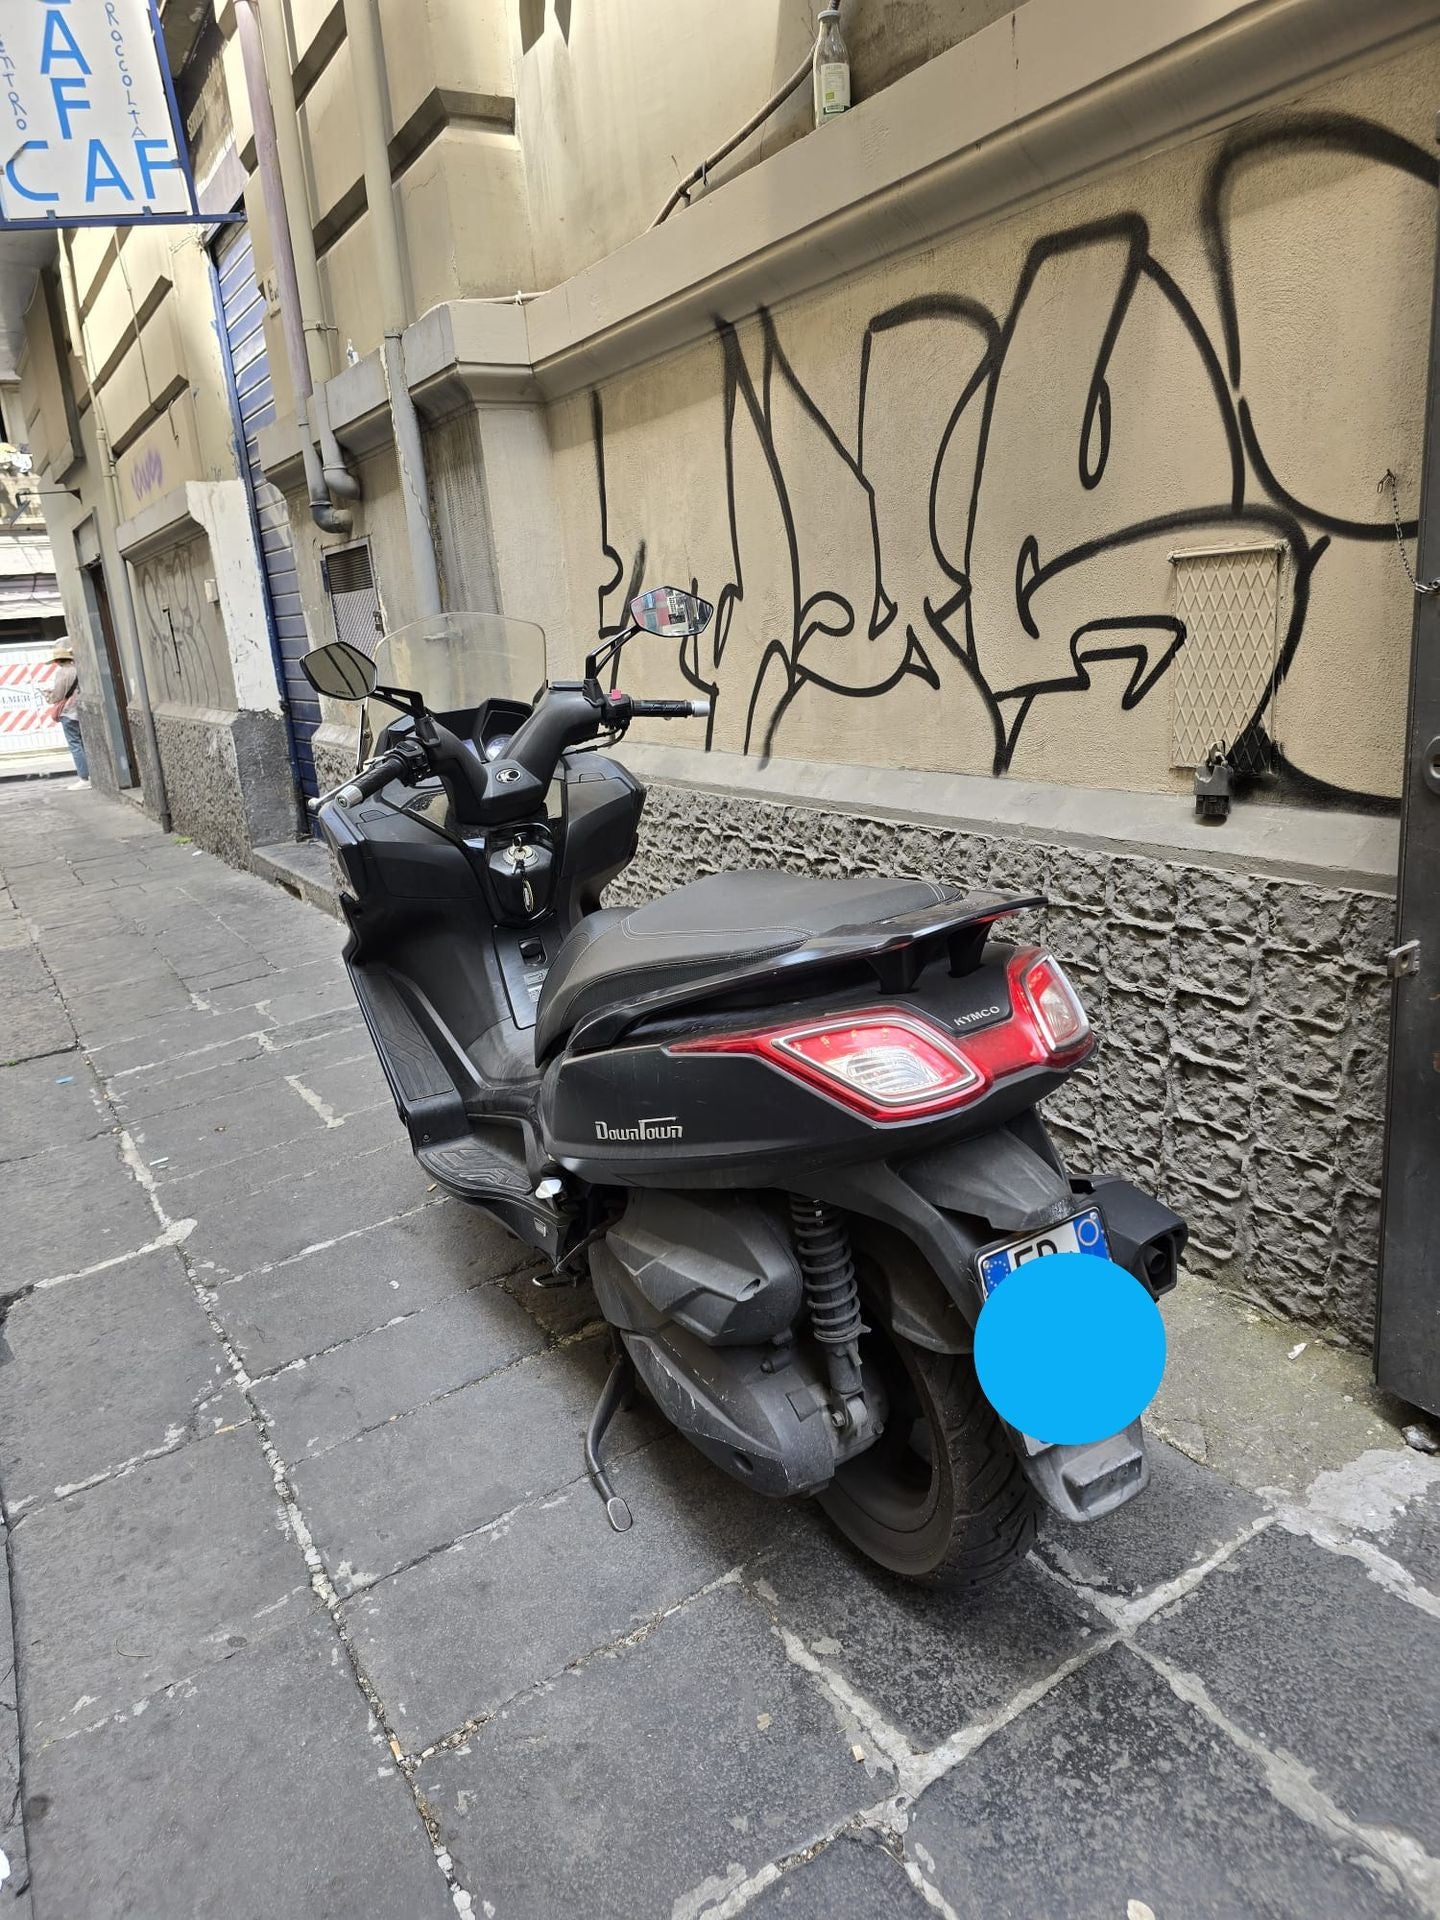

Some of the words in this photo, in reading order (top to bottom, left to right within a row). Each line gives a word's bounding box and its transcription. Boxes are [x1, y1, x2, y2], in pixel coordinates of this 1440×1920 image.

[37, 0, 92, 140] AF
[5, 138, 183, 203] CAF
[953, 1006, 1000, 1026] KYMCO
[595, 1116, 683, 1141] DownTown
